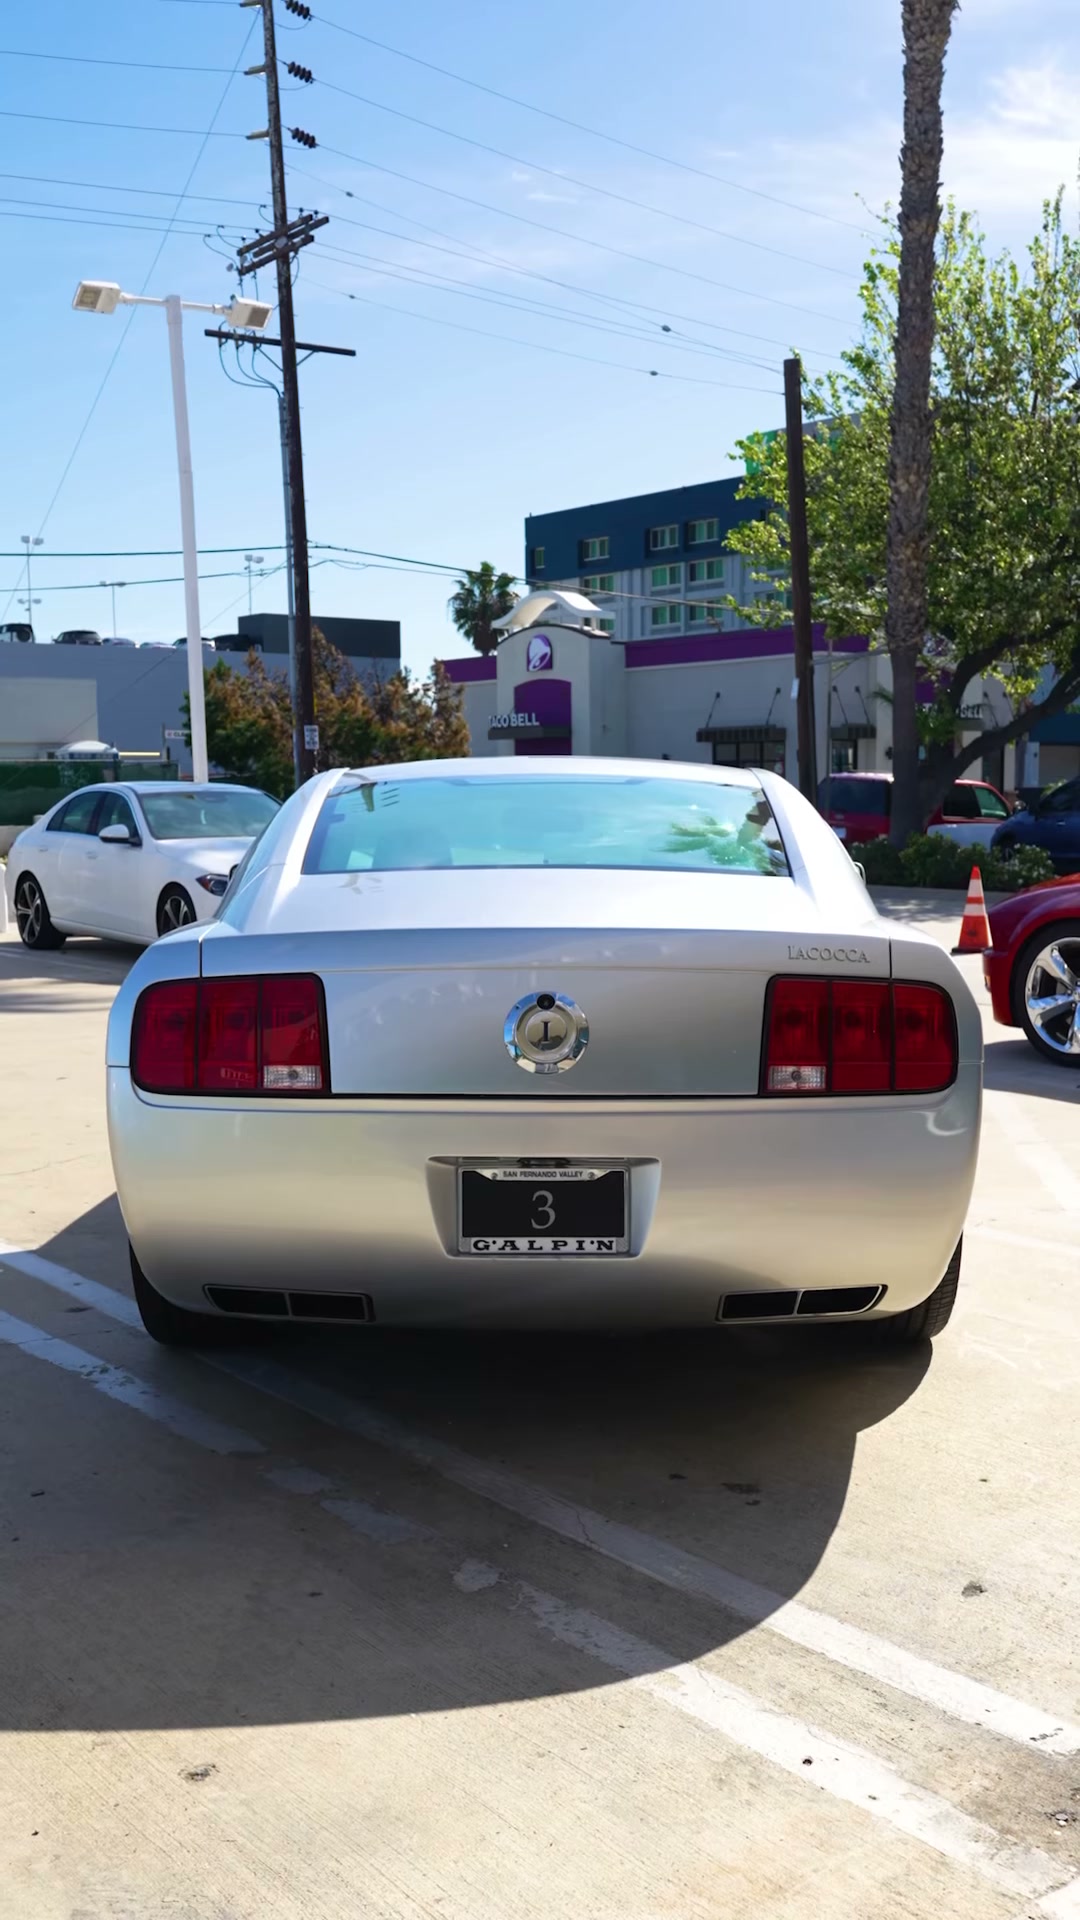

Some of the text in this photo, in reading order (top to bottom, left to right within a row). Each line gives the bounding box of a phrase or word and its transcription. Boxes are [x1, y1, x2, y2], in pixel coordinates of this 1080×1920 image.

[510, 712, 540, 727] BELL
[503, 1170, 583, 1178] SAN FERNANDO VALLEY
[531, 1190, 556, 1229] 3
